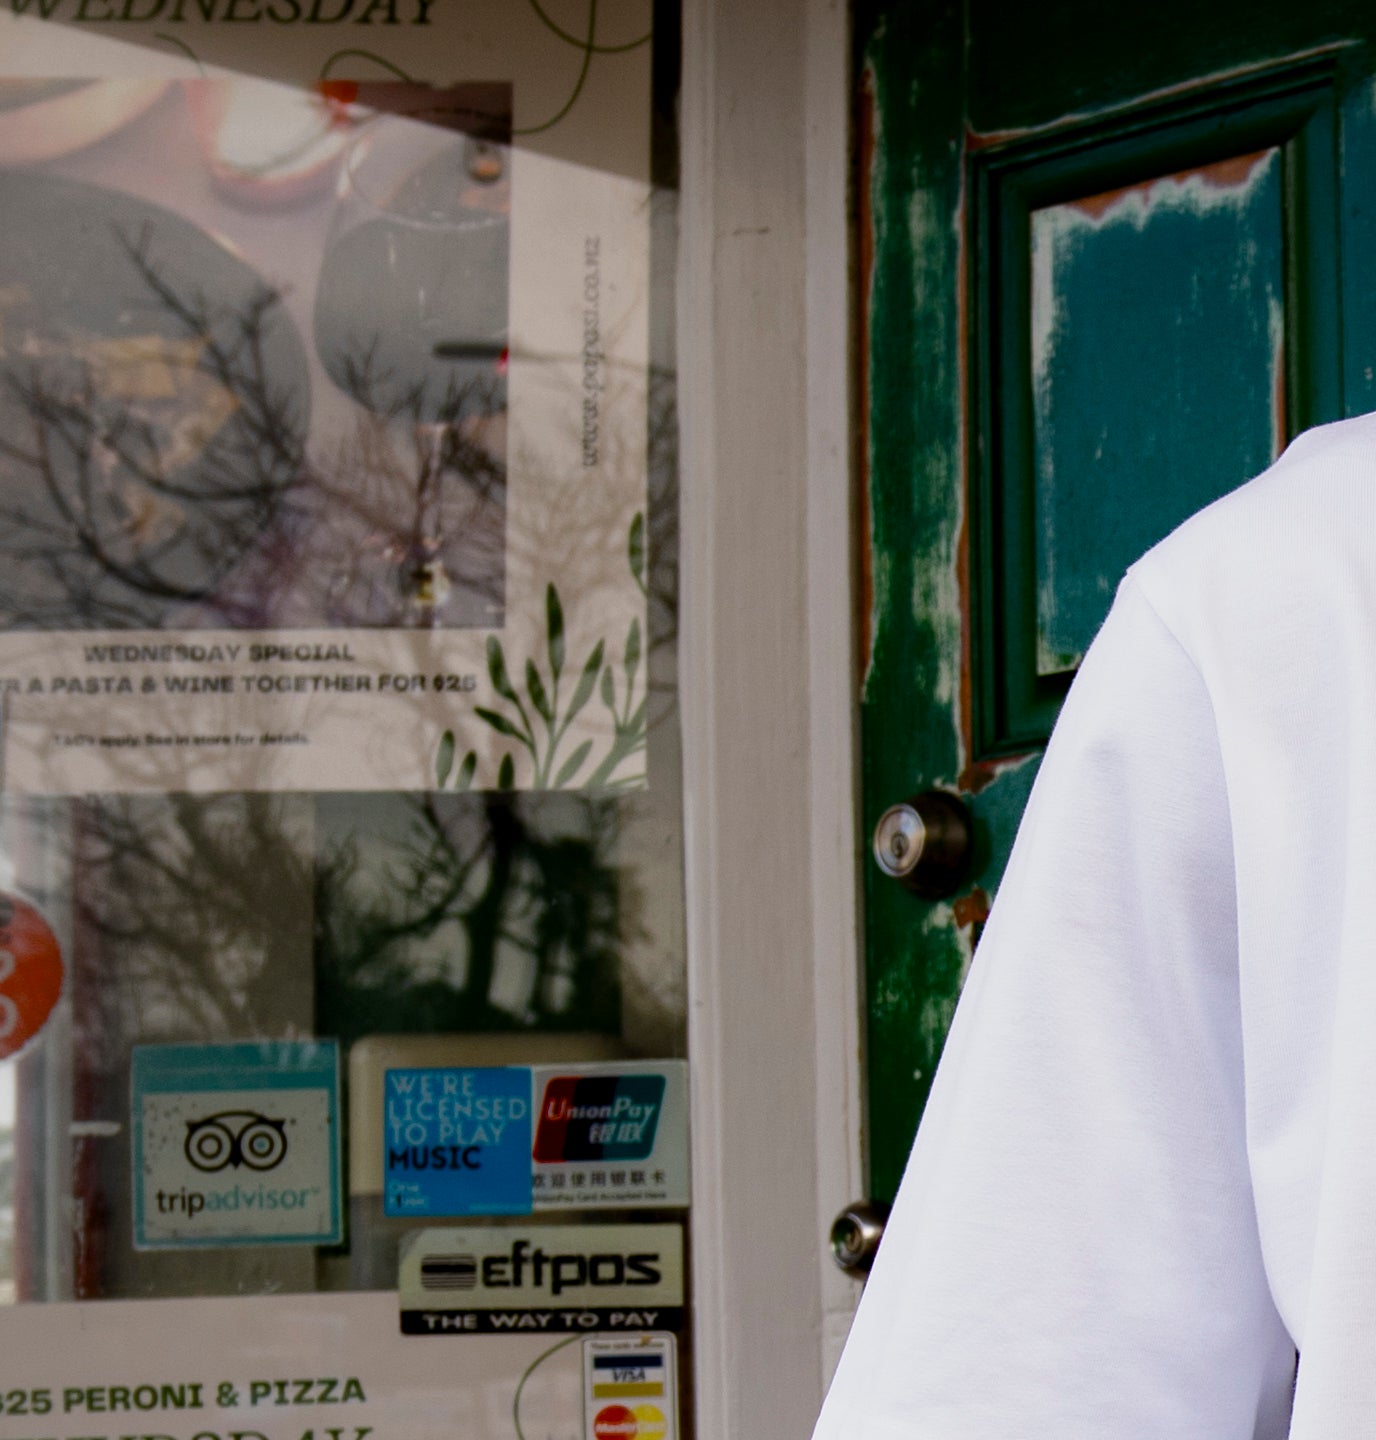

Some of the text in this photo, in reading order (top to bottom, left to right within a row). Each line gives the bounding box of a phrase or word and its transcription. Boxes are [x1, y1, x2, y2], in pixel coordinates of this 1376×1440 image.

[84, 644, 355, 662] WEDNESDAY SPECIAL
[28, 678, 44, 694] A
[51, 677, 135, 694] PASTA
[140, 677, 157, 693] &
[163, 676, 234, 692] WINE
[240, 675, 371, 692] TOGETHER
[378, 674, 426, 691] FOR
[389, 1098, 527, 1121] LICENSED
[546, 1098, 656, 1121] UnionPay
[391, 1123, 504, 1144] TO PLAY
[389, 1146, 482, 1169] MUSIC
[155, 1184, 309, 1220] tripadvisor
[482, 1240, 662, 1296] eftpos
[422, 1311, 659, 1329] THE WAY TO PAY
[611, 1369, 646, 1382] VISA
[63, 1383, 204, 1413] PERONI
[216, 1382, 240, 1408] &
[250, 1377, 367, 1406] PIZZA
